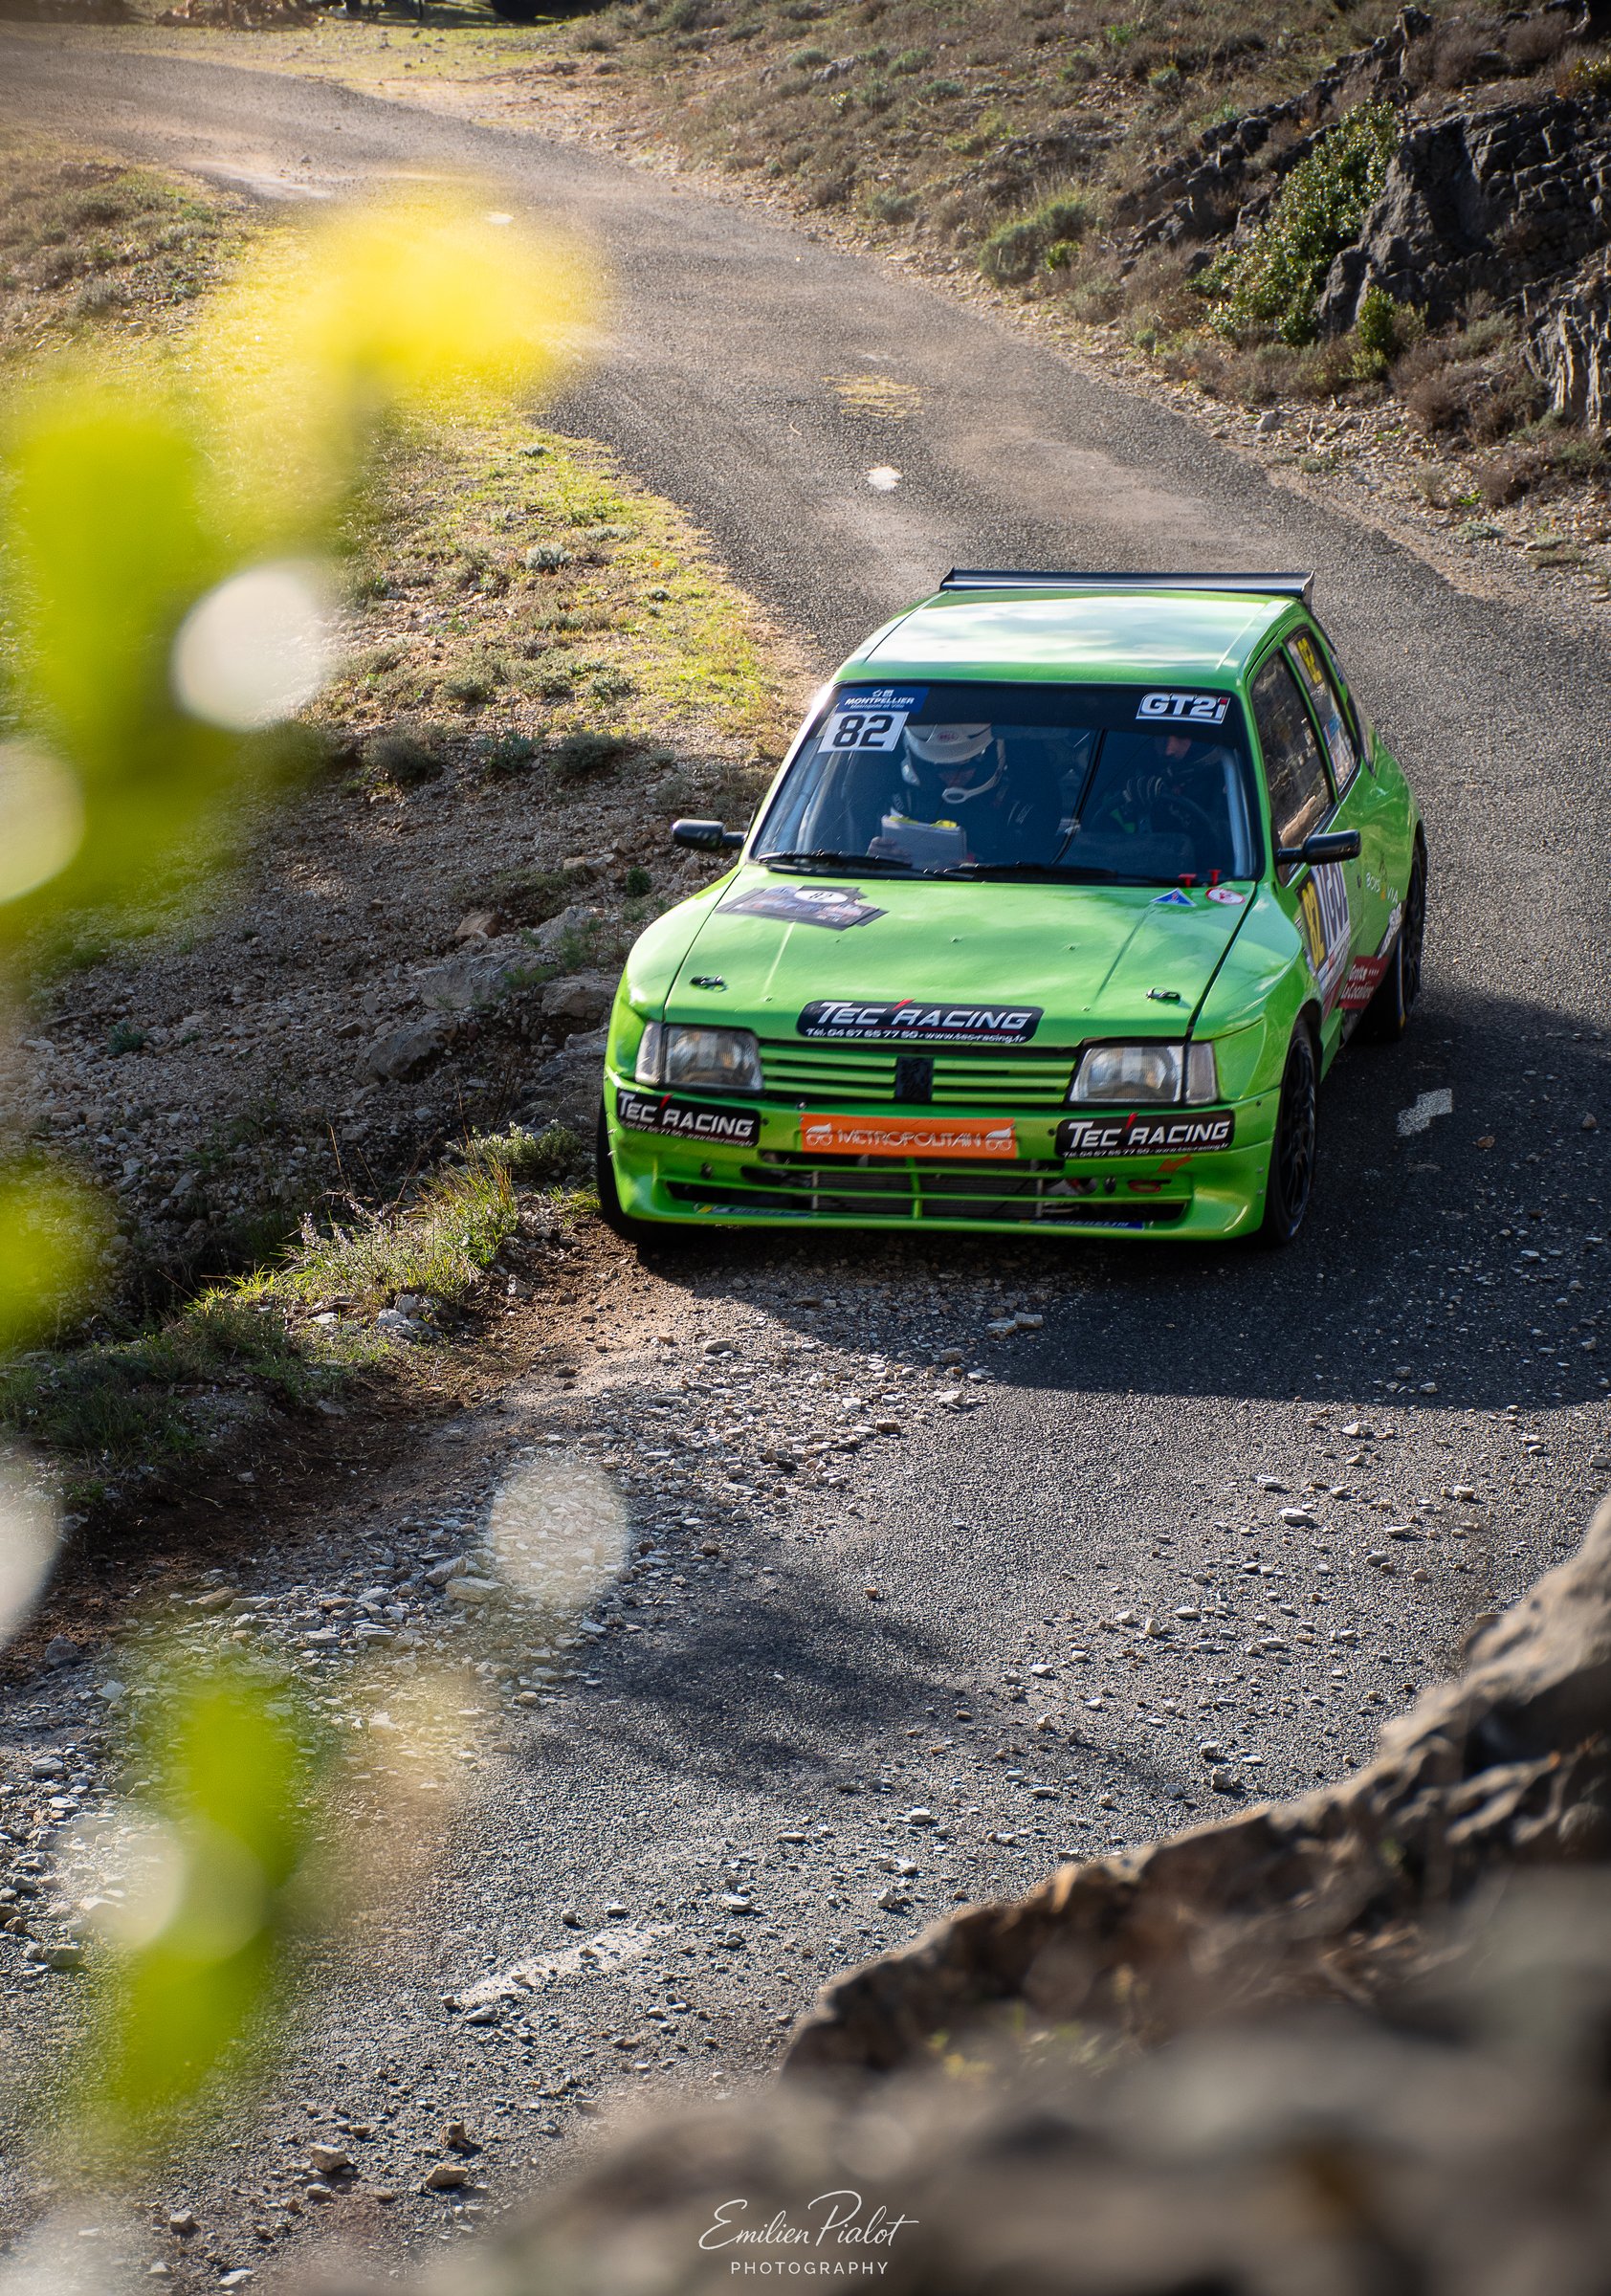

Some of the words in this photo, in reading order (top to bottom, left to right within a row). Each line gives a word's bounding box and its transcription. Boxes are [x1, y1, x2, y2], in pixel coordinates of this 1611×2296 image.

[844, 697, 915, 706] MONTPELLIER
[1140, 693, 1228, 719] GT2i
[832, 715, 894, 747] 82
[1302, 881, 1326, 969] 82
[882, 1029, 900, 1038] 77
